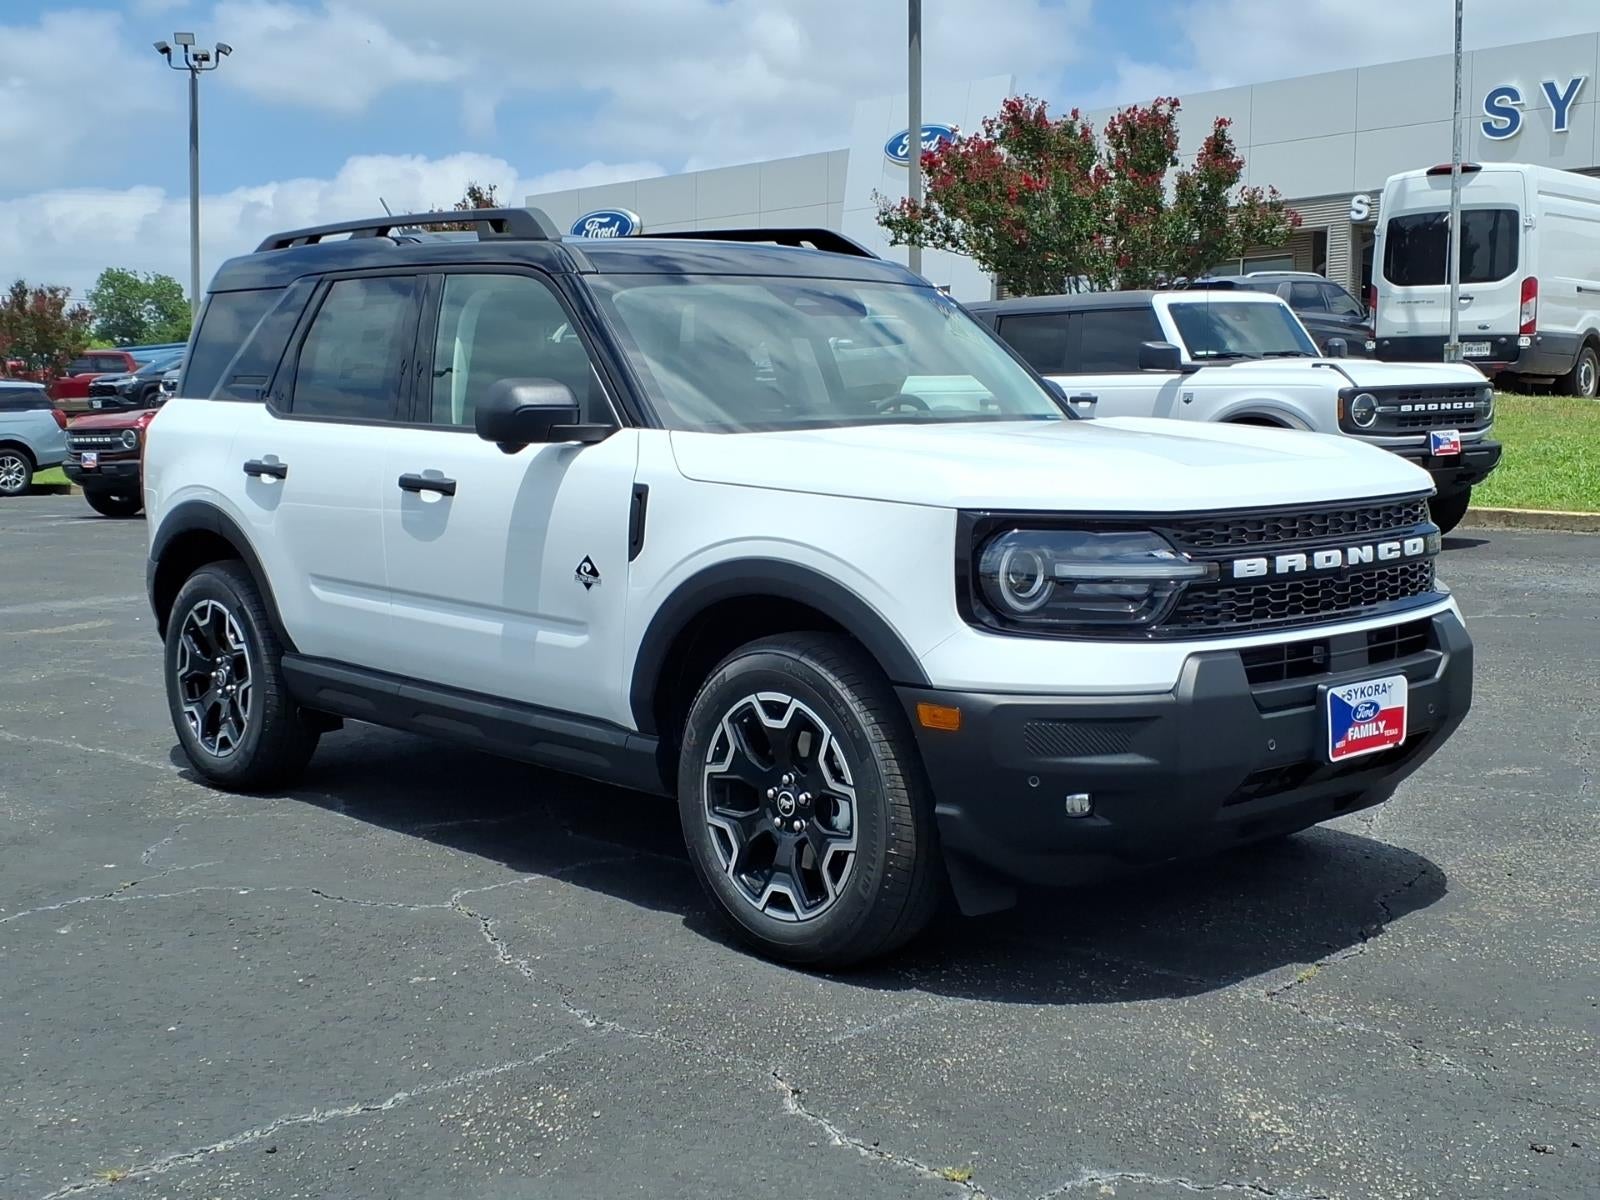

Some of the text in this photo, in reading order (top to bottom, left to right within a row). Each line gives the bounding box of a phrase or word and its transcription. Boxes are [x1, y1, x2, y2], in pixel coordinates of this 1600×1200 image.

[1480, 76, 1585, 140] SY
[1350, 194, 1371, 221] S
[581, 216, 621, 238] Ford
[1400, 401, 1475, 412] BRONCO
[1233, 537, 1425, 579] BRONCO
[1345, 682, 1388, 702] SYKORA
[1355, 702, 1377, 720] Ford
[1347, 720, 1387, 742] FAMILY
[1383, 727, 1399, 737] TEXAS
